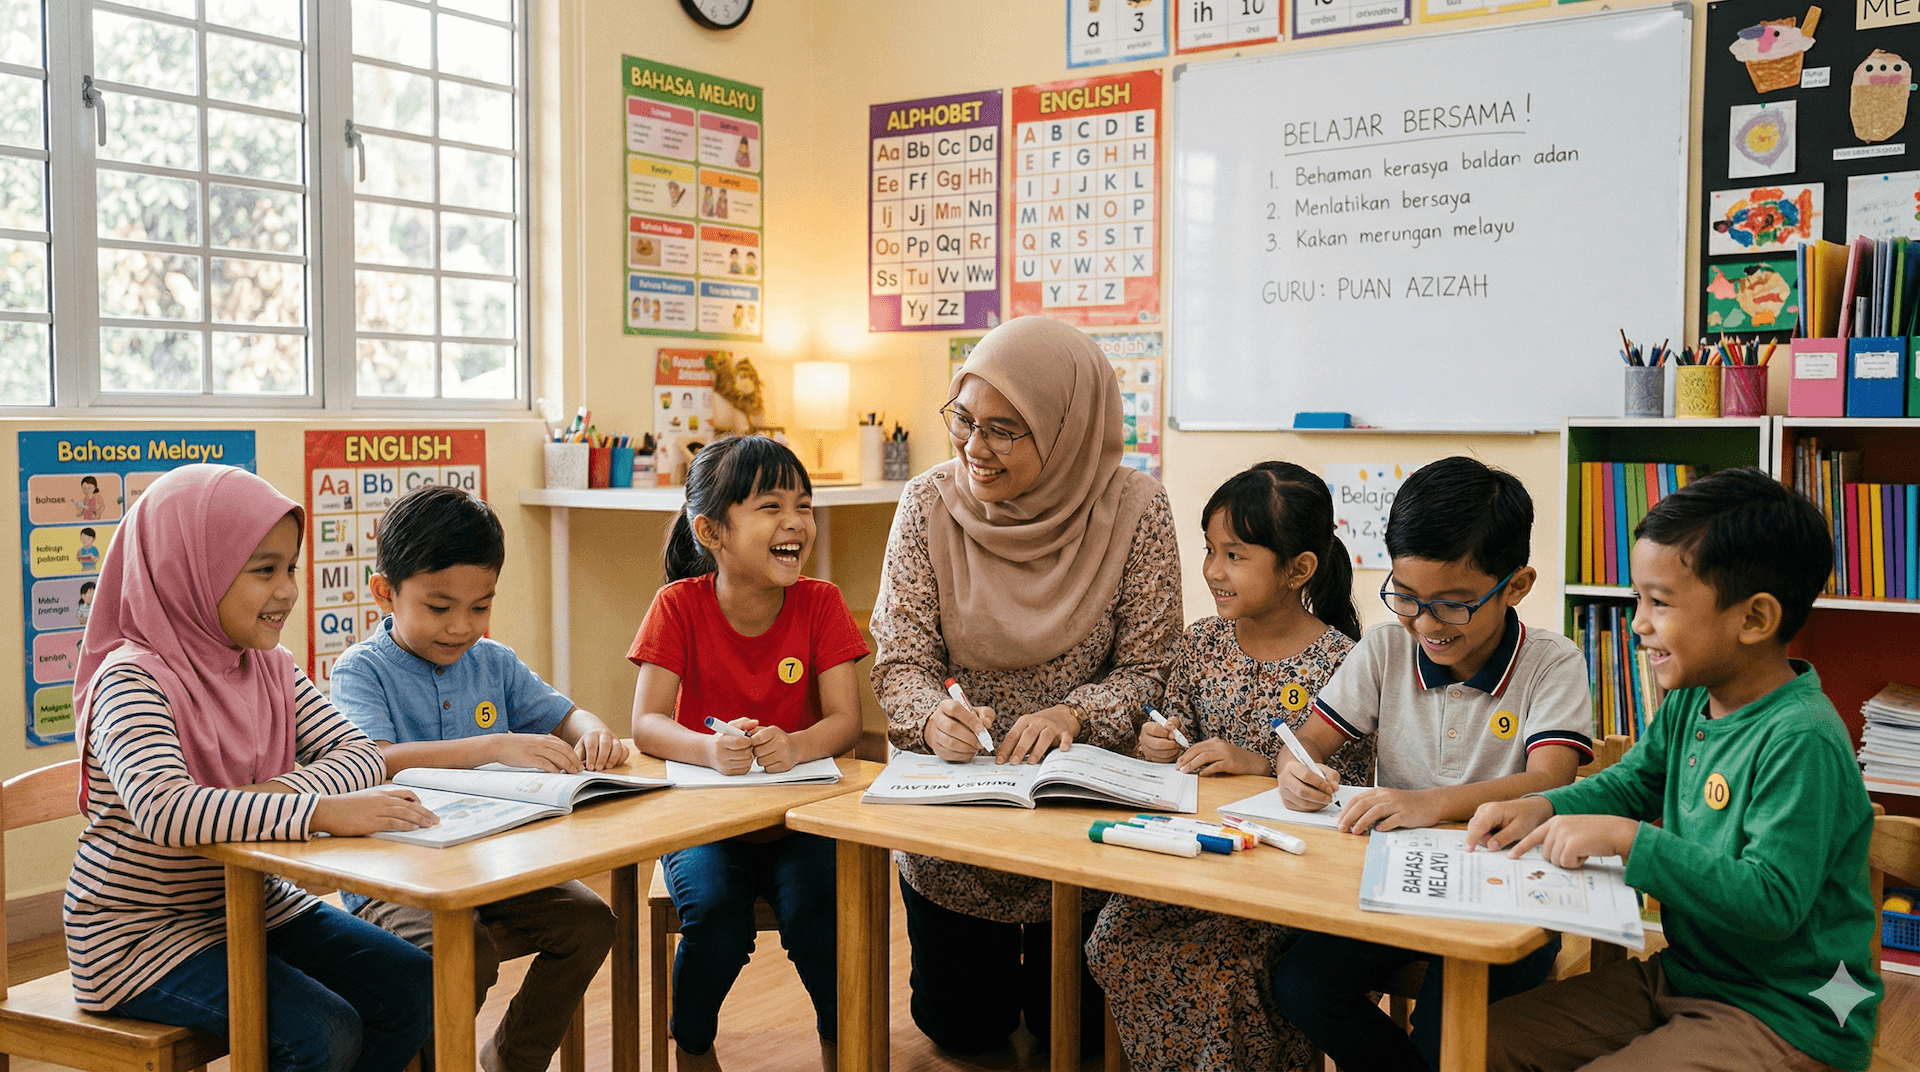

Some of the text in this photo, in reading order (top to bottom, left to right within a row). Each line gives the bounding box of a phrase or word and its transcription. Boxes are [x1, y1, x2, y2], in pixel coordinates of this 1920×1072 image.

[1133, 12, 1144, 32] 3
[1194, 1, 1213, 23] ih
[1863, 0, 1920, 20] ME
[1087, 21, 1099, 38] a
[631, 66, 757, 113] BAHASA MELAYU
[1039, 82, 1131, 114] ENGLISH
[886, 100, 984, 132] ALPHOBET
[1023, 115, 1145, 144] A B C D E
[1284, 113, 1384, 147] BELAJAR
[877, 133, 994, 163] Aa Bb Cc Dd
[1025, 143, 1146, 170] E F G H H
[1295, 166, 1372, 186] Behaman
[1384, 158, 1449, 179] kerasya
[1533, 144, 1579, 165] adan
[877, 167, 993, 193] Ee Ff Gg Hh
[1028, 171, 1144, 197] I J J K L
[909, 205, 926, 226] Jj
[936, 202, 962, 220] Mm
[969, 200, 993, 218] Nn
[1021, 199, 1145, 225] M M N O P
[1266, 202, 1281, 220] 2.
[1402, 190, 1471, 214] bersaya
[875, 232, 991, 258] Oo Pp Qq Rr
[1022, 226, 1144, 251] Q R S S T
[1266, 216, 1515, 252] 3. Kakan merungan melayu
[877, 264, 994, 287] Ss Tu Vv Ww
[1023, 254, 1145, 277] U V W X X
[1050, 283, 1116, 302] Y Z Z
[1338, 277, 1391, 301] PUAN
[1405, 274, 1489, 298] AZIZAH
[907, 298, 959, 321] Yy Zz
[58, 438, 225, 463] Bahasa Melayu
[345, 435, 452, 462] ENGLISH
[319, 474, 350, 495] Aa
[363, 473, 393, 494] Bb
[447, 471, 475, 490] Dd
[1341, 484, 1396, 512] Belaja
[321, 613, 353, 634] Qq
[785, 663, 796, 678] 7
[1289, 689, 1299, 705] 8
[482, 706, 490, 722] 5
[1499, 716, 1510, 733] 9
[1708, 781, 1725, 802] 10
[1402, 850, 1424, 895] BAHASA
[1428, 852, 1449, 898] MELAYU
